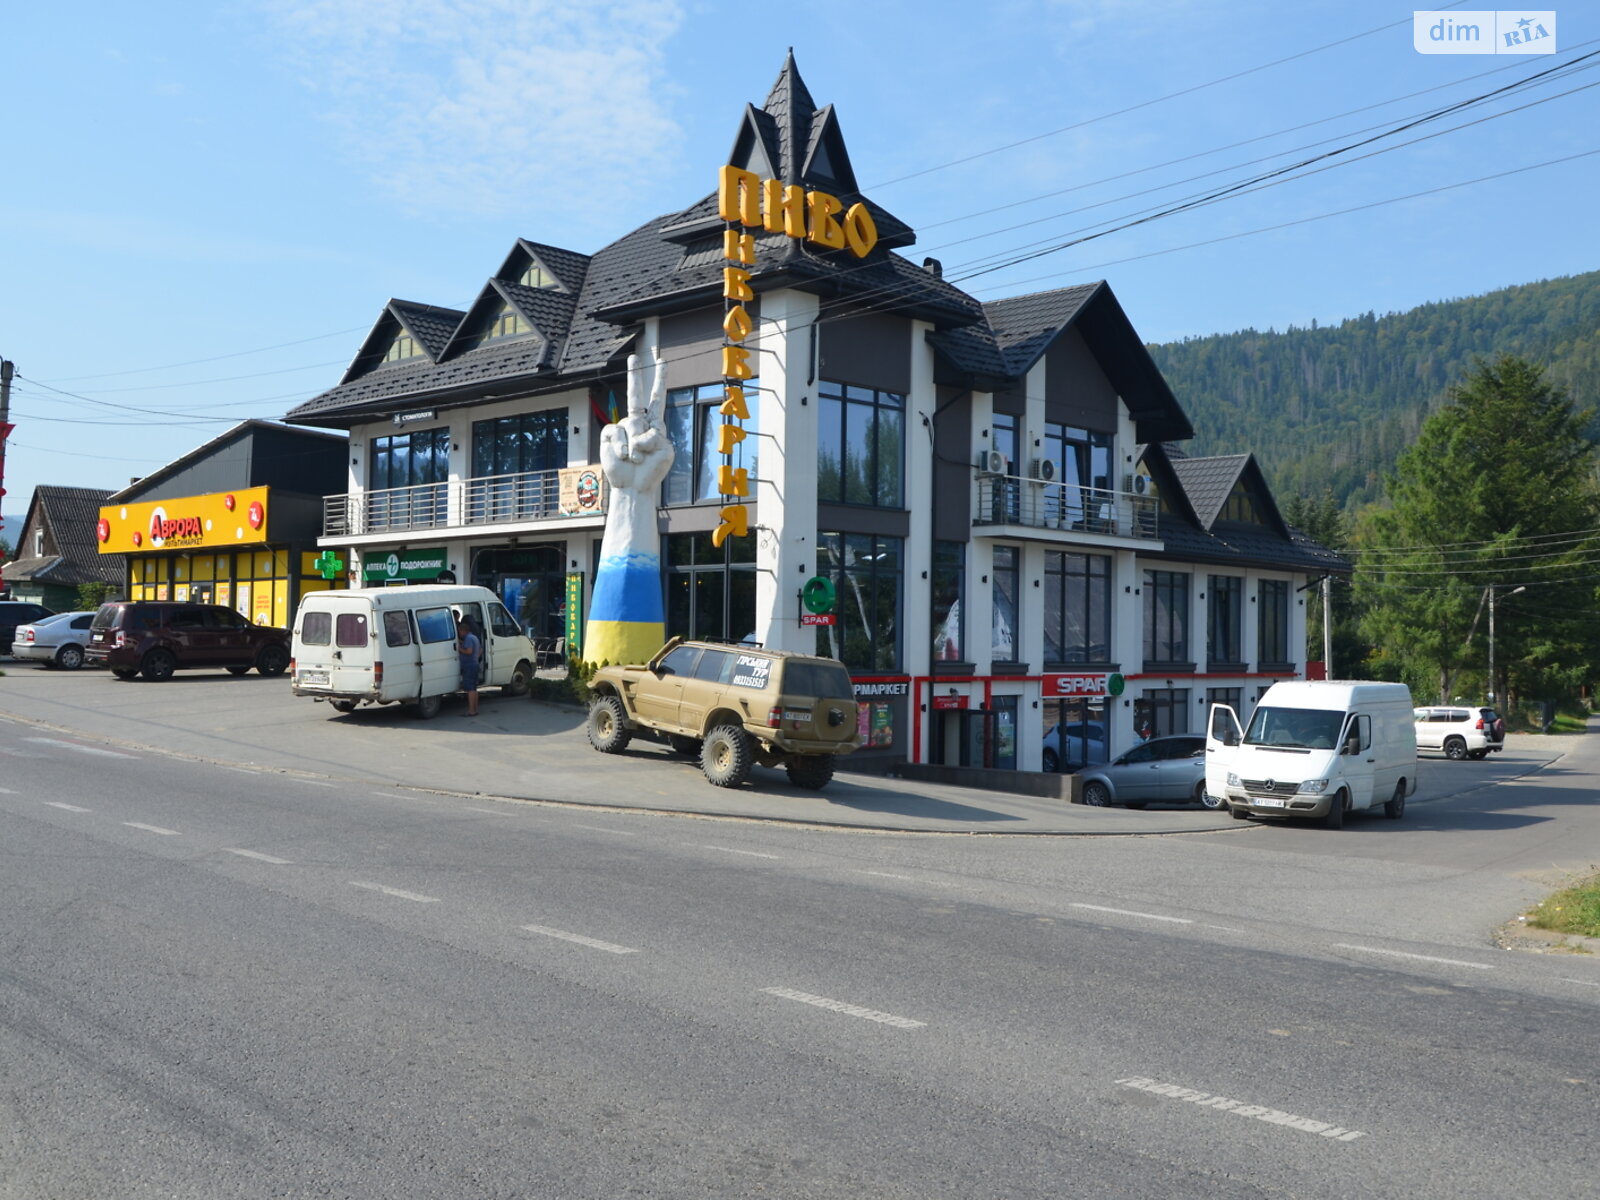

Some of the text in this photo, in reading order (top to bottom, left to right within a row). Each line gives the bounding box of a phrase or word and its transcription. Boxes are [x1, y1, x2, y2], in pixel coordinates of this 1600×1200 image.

[719, 164, 878, 258] ПИВО
[366, 559, 443, 571] АПТЕКА ПОДОРОЖНИК
[803, 616, 829, 624] SPAR
[752, 667, 769, 677] ТУР
[1057, 677, 1107, 693] SPAR
